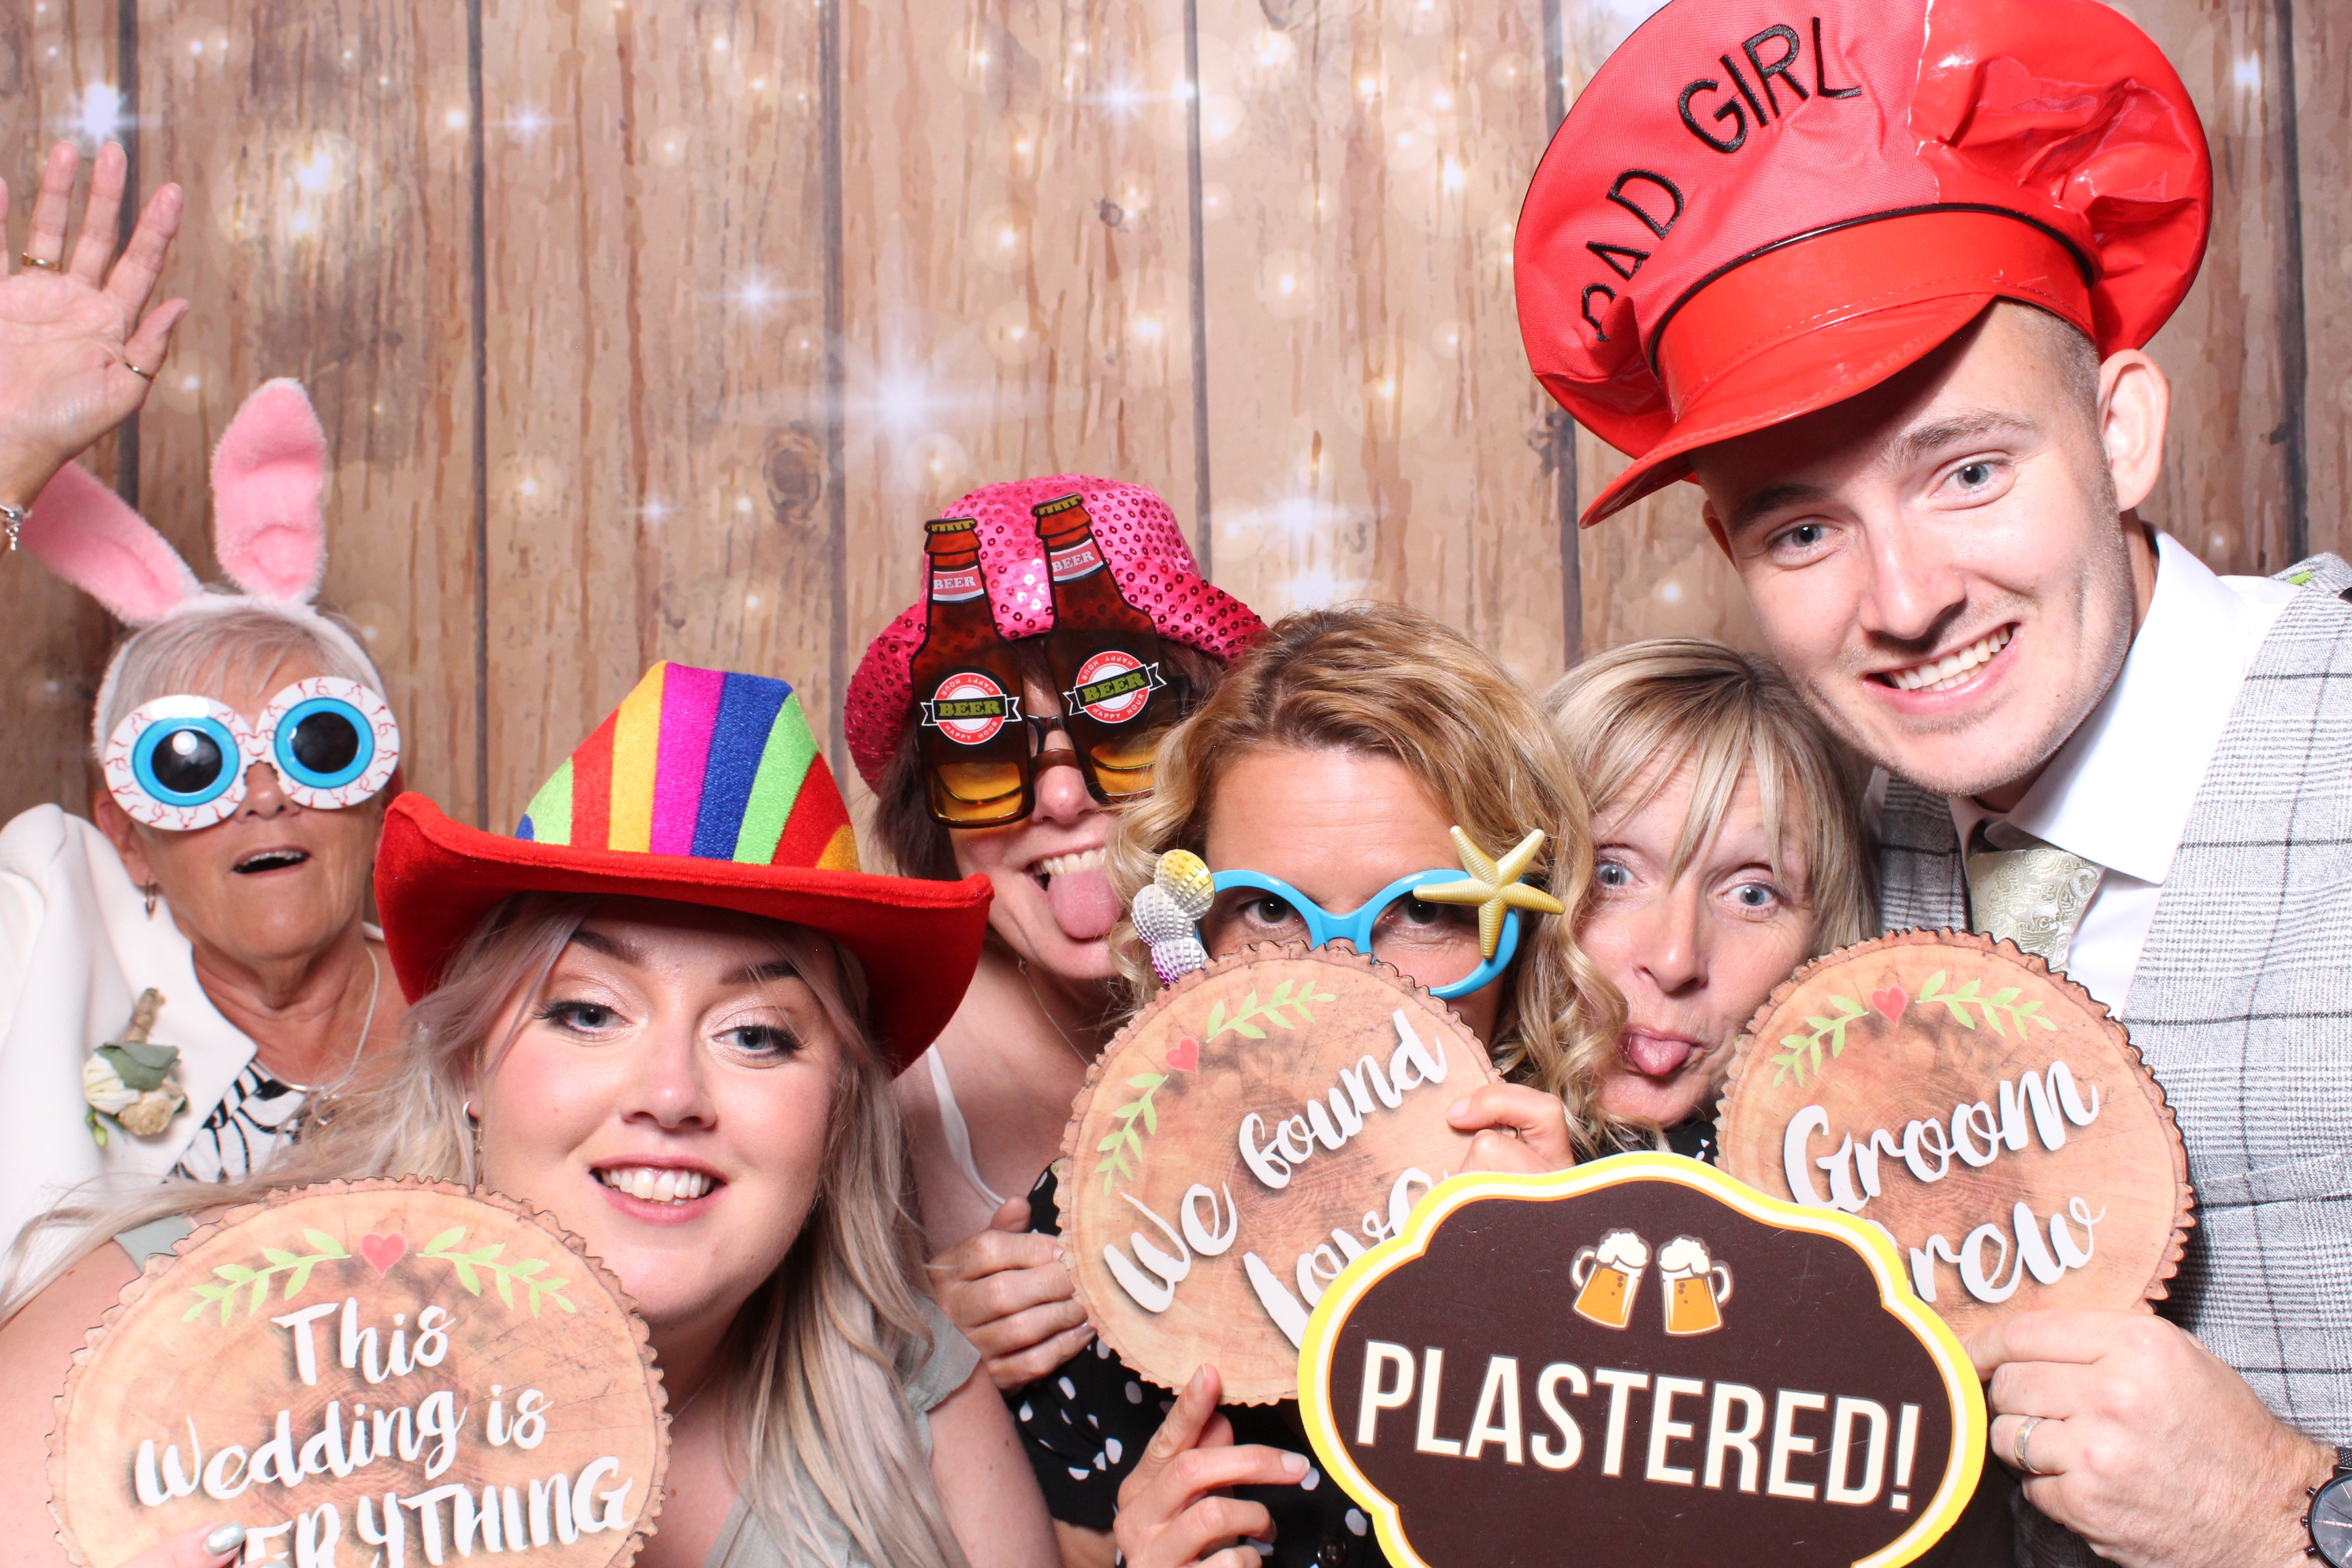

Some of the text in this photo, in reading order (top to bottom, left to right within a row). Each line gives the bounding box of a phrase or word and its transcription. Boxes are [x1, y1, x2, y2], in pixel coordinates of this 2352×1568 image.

[1677, 16, 1862, 154] GIRL
[1051, 551, 1095, 572] BEER
[933, 576, 977, 590] BEER
[1081, 655, 1134, 681] HAPPY HOUR
[941, 677, 994, 696] HAPPY HOUR
[1081, 672, 1146, 703] BEER
[938, 700, 1001, 717] BEER
[1092, 693, 1145, 719] HAPPY HOUR
[945, 721, 998, 740] HAPPY HOUR
[1783, 1060, 2100, 1213] Groom
[1103, 1181, 1238, 1313] We
[1865, 1196, 2106, 1303] rew
[272, 1296, 457, 1386] This
[1356, 1339, 1922, 1512] PLASTERED!
[135, 1384, 554, 1507] Wedding is
